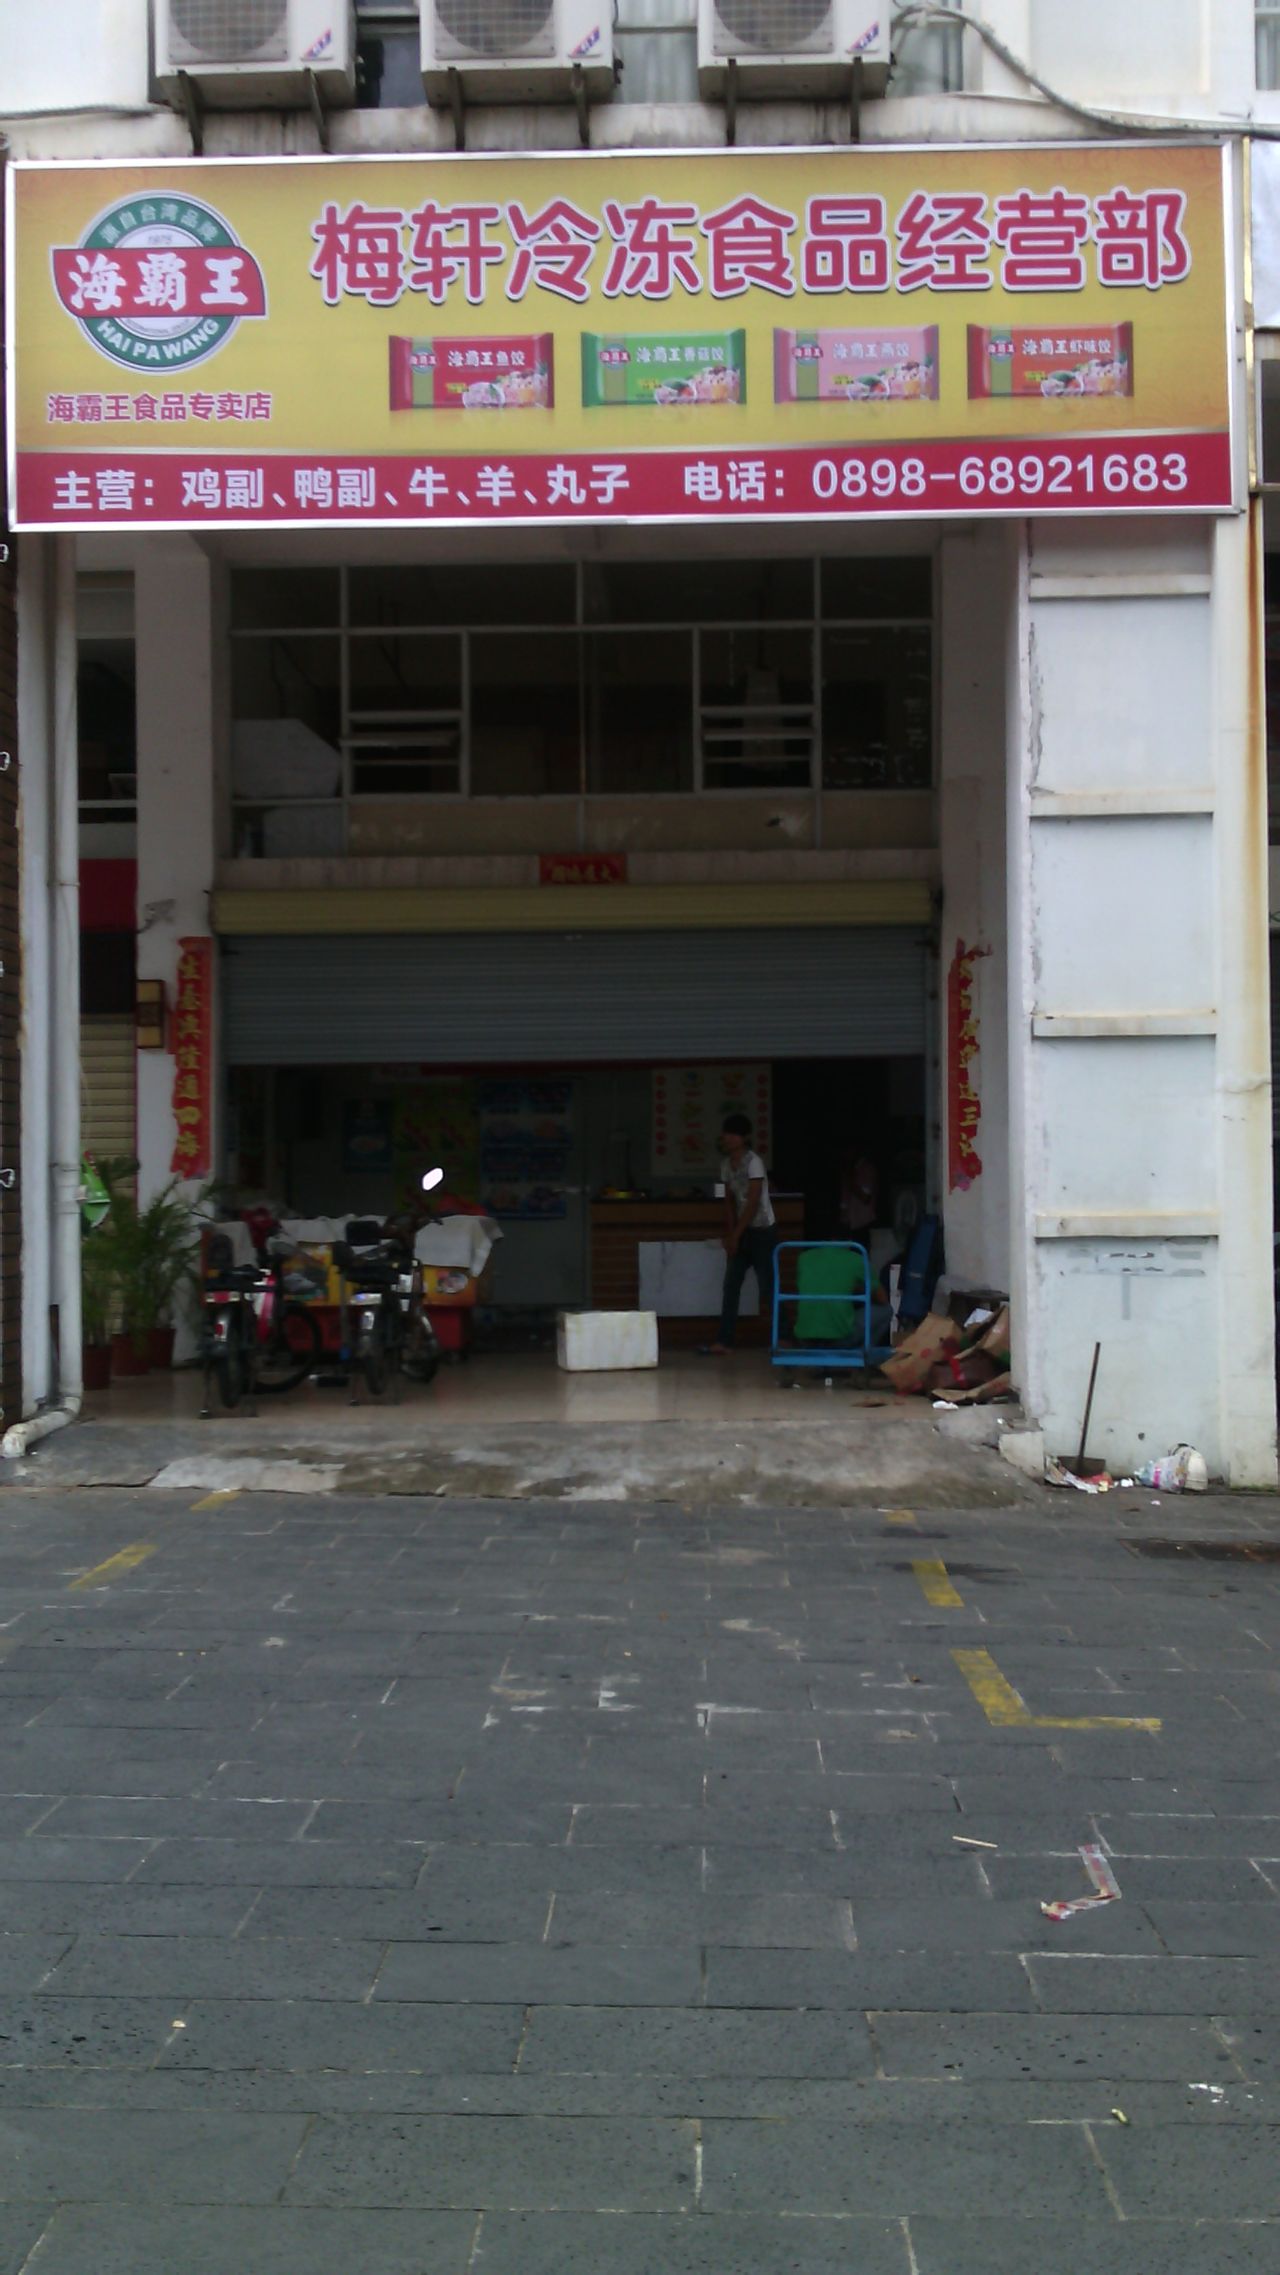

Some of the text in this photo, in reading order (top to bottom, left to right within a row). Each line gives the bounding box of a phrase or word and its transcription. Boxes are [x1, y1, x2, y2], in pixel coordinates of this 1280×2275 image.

[312, 188, 1189, 302] 梅轩冷冻食品经营部
[69, 253, 248, 311] 海霸王
[97, 320, 132, 352] HAI
[132, 342, 160, 360] PA
[162, 319, 220, 359] WANG
[48, 392, 272, 422] 海霸王食品专卖店
